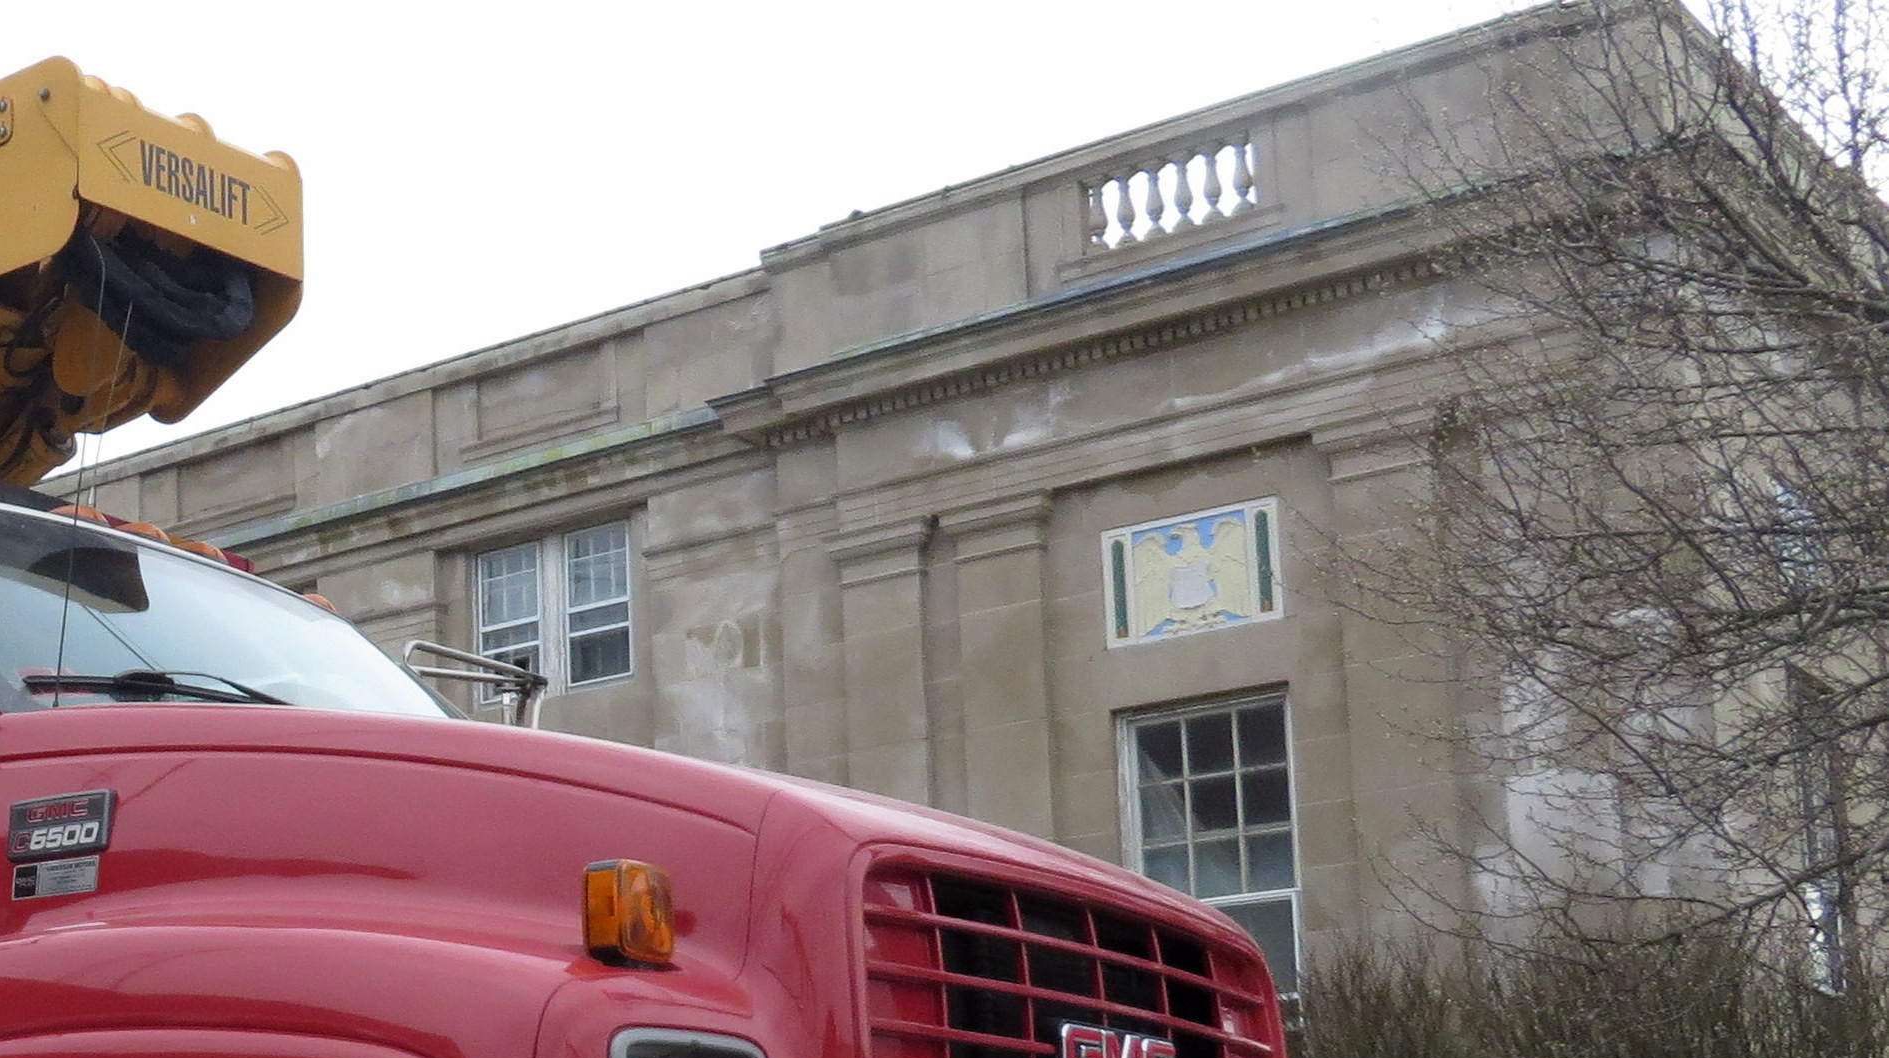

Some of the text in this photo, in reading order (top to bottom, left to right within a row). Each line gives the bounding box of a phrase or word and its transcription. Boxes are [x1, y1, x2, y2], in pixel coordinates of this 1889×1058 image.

[139, 139, 251, 226] VERSALIFT
[26, 798, 89, 823] GMC
[11, 821, 100, 853] C6500
